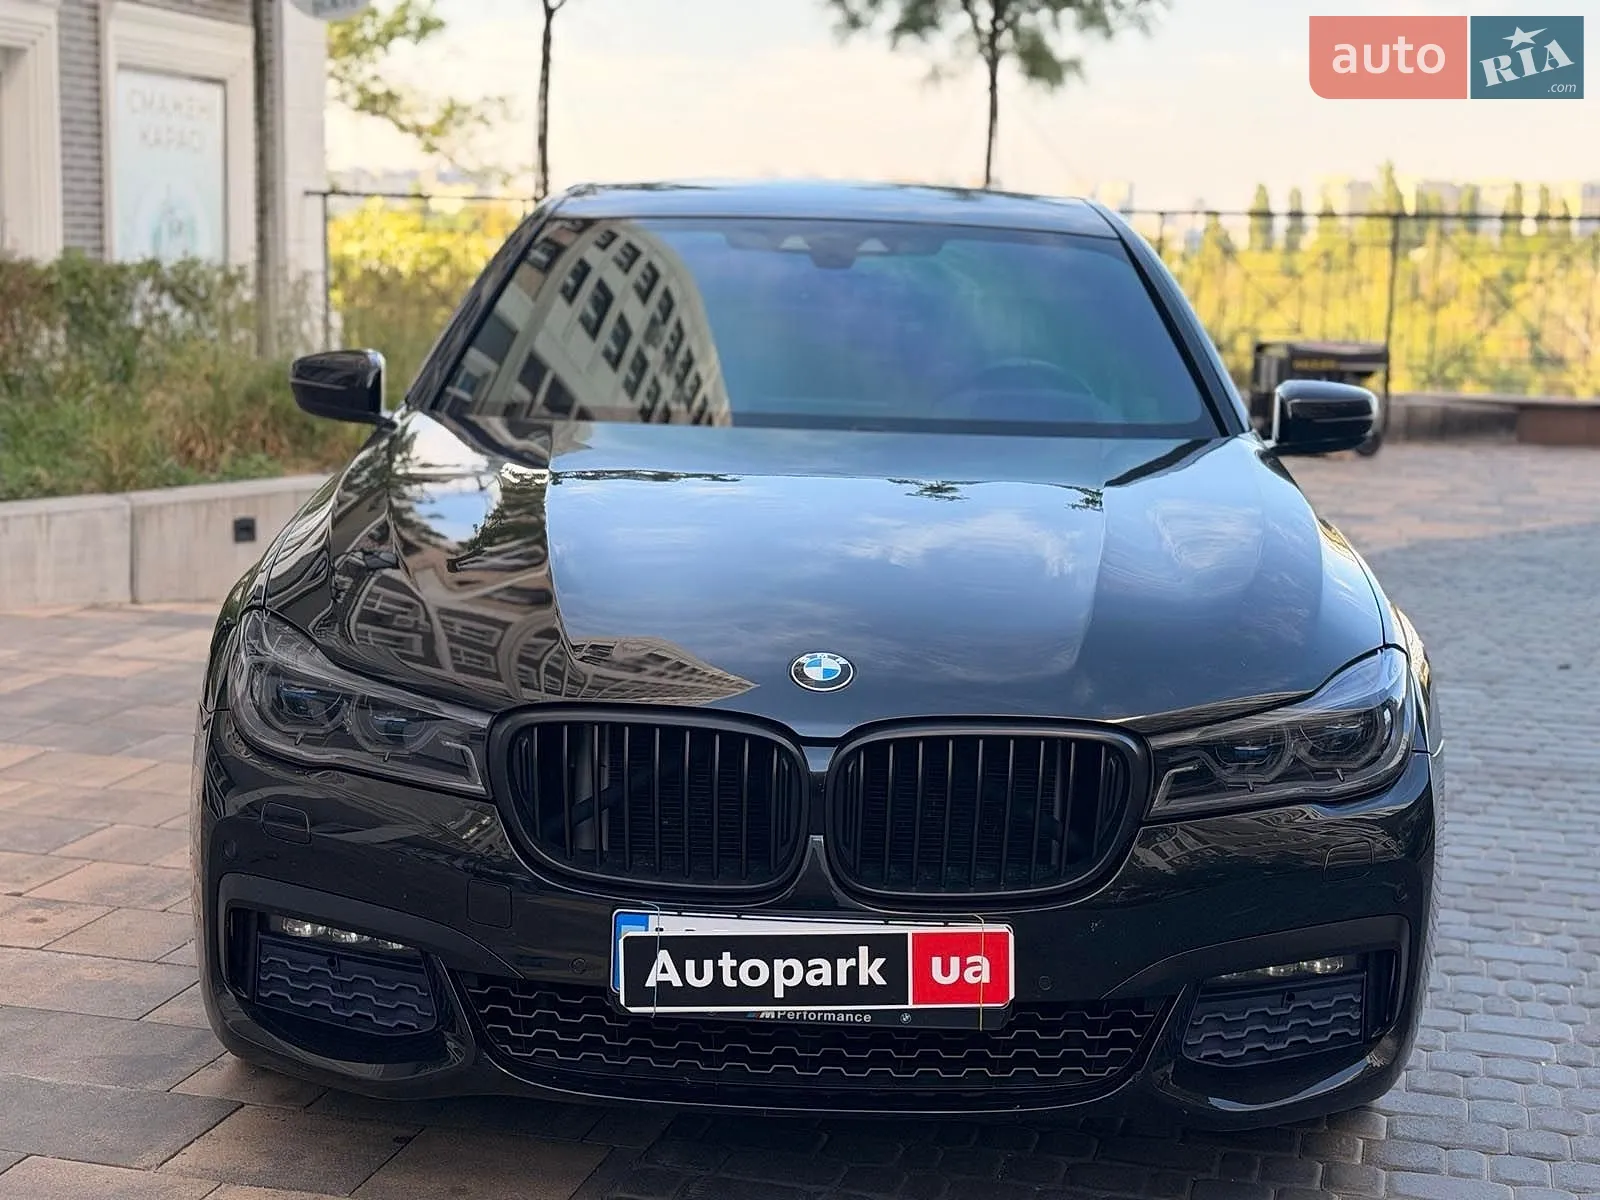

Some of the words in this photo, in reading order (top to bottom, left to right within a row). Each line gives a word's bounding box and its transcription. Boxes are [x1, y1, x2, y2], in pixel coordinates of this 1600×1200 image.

[644, 945, 887, 998] Autopark
[931, 954, 991, 985] ua
[777, 1010, 872, 1023] Performance
